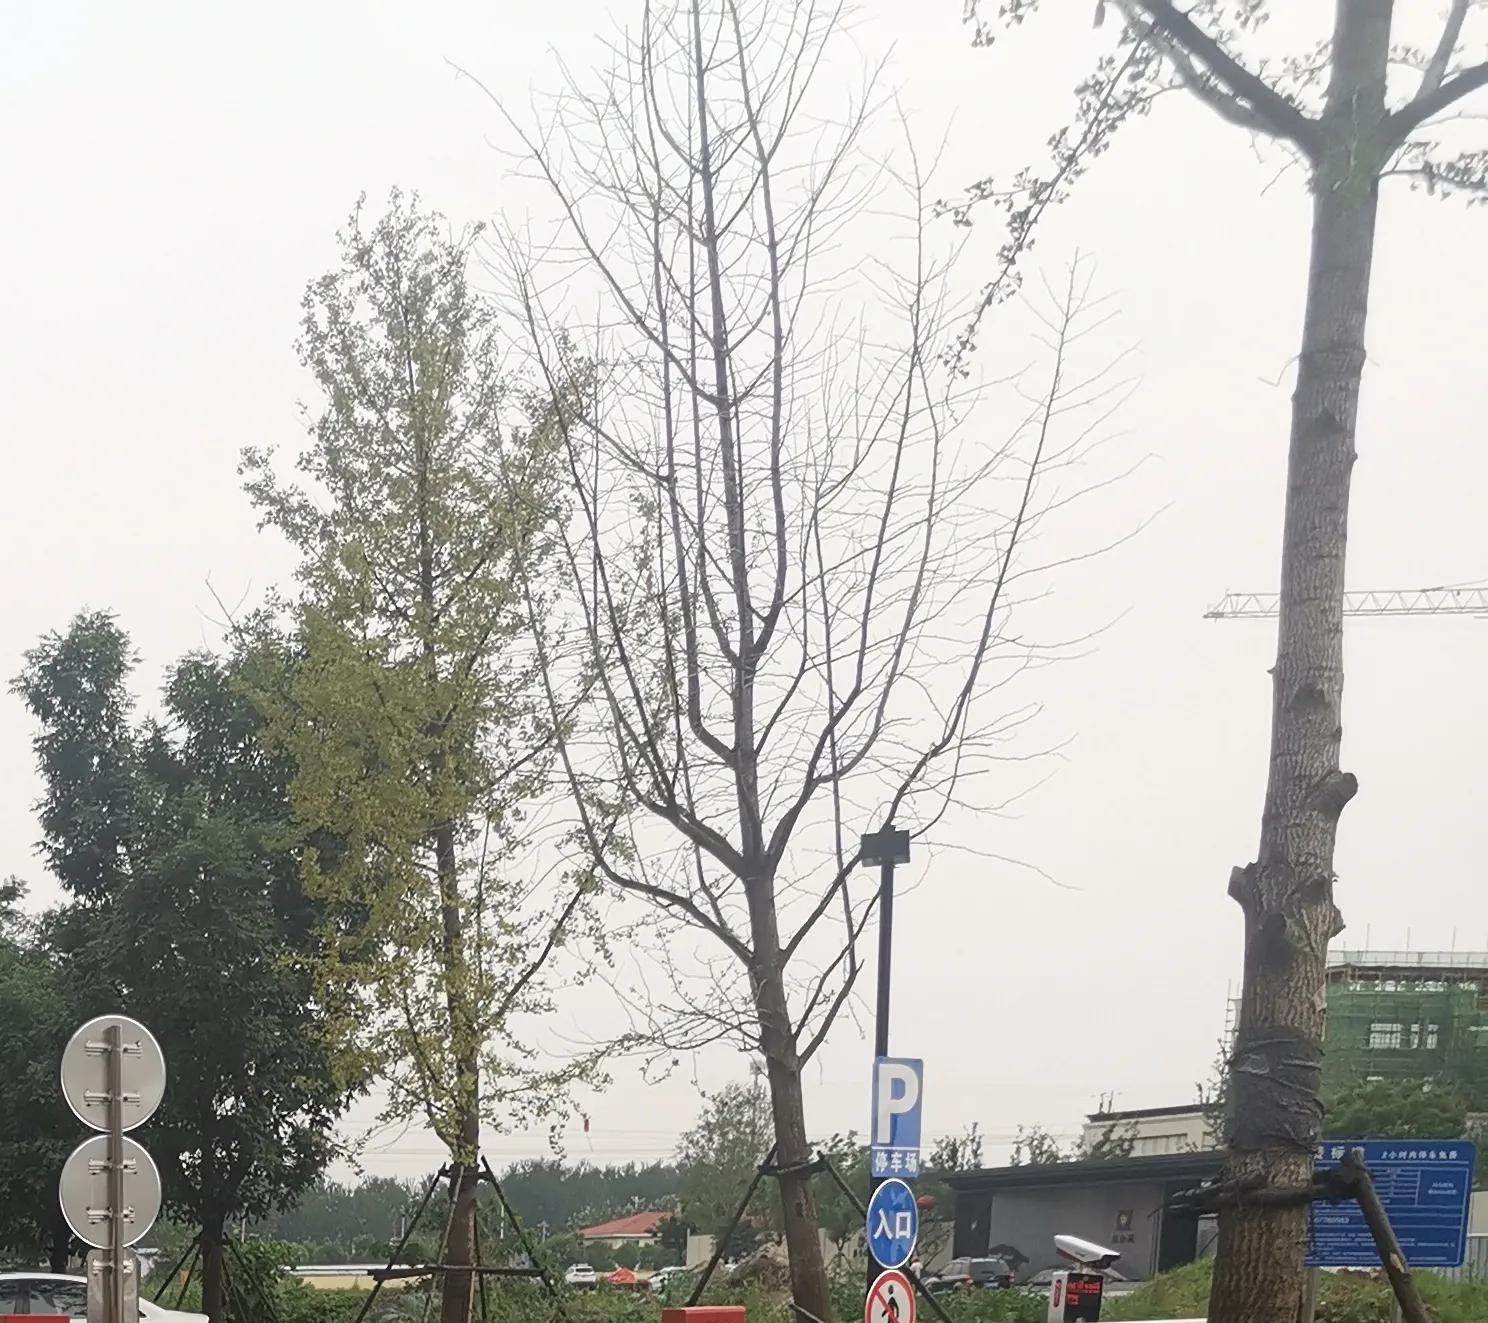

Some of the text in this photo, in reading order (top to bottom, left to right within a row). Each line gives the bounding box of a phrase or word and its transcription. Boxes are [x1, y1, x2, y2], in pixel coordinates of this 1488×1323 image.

[877, 1063, 918, 1144] P
[875, 1152, 917, 1173] 停车场
[1380, 1150, 1459, 1160] 2小时内停车免费
[873, 1208, 912, 1240] 入口
